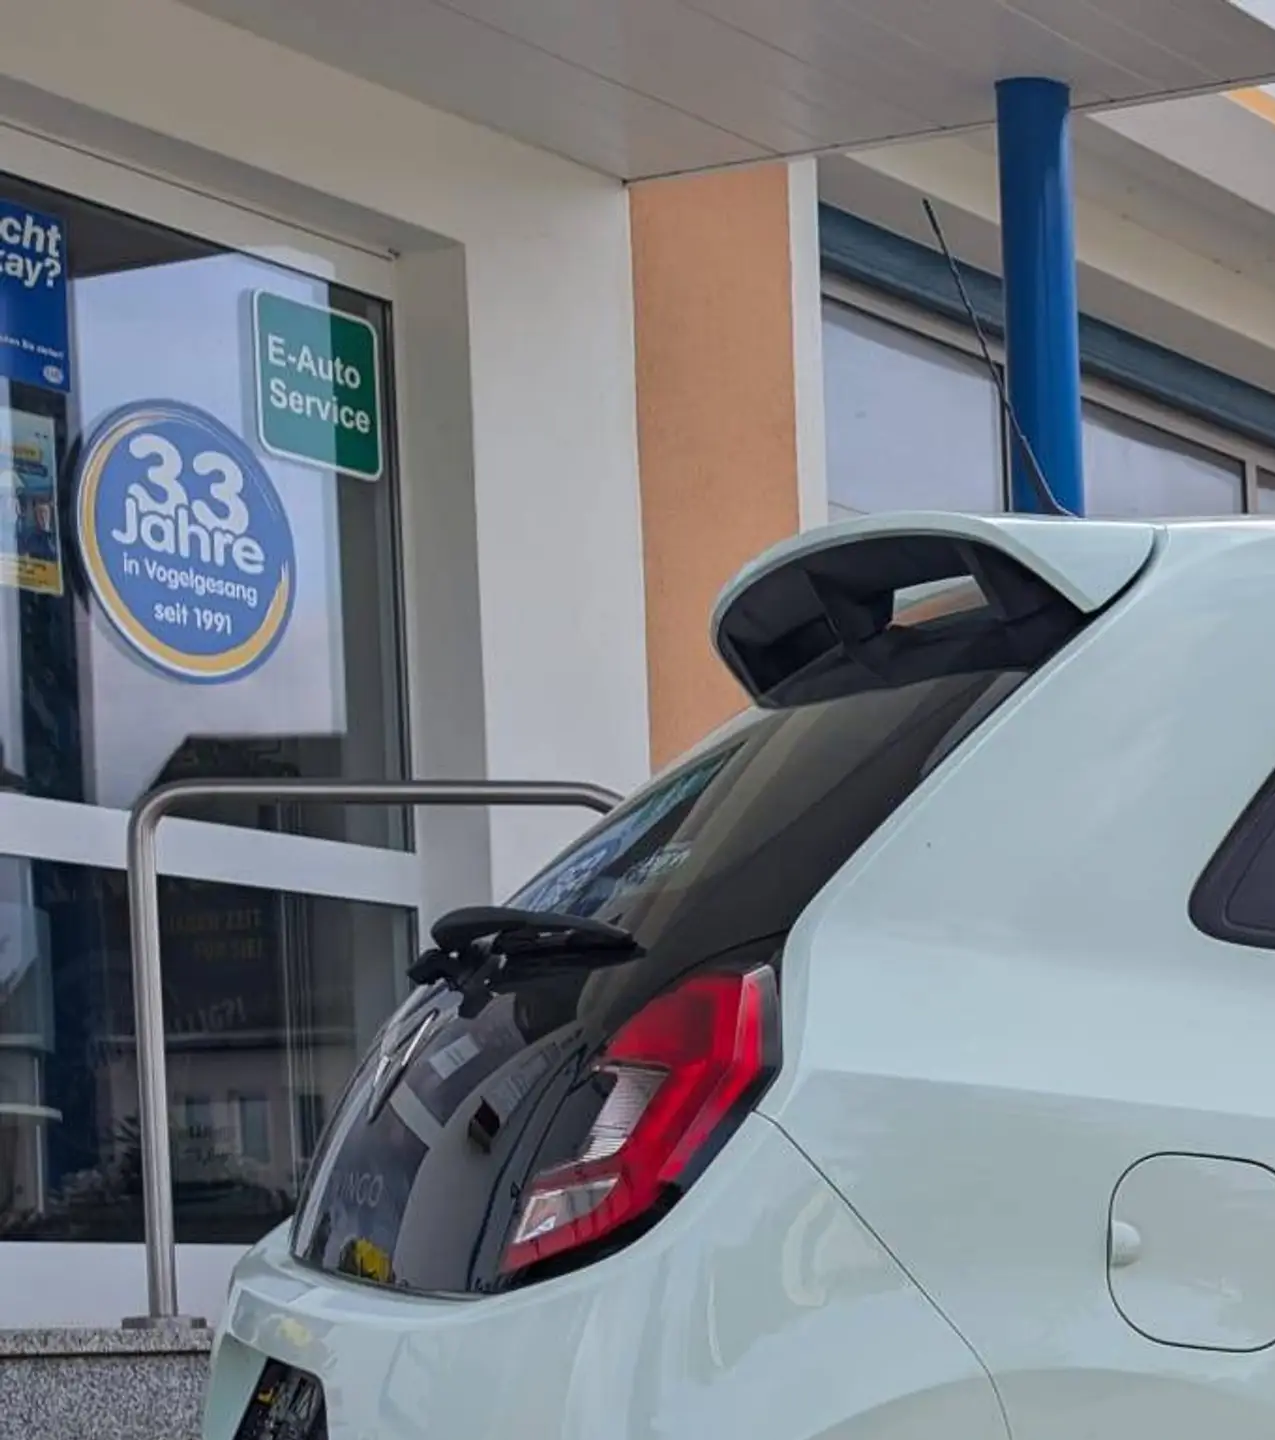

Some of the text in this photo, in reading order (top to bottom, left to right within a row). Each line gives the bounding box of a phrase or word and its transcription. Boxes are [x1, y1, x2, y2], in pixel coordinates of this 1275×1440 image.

[268, 333, 361, 389] E-Auto
[270, 377, 371, 434] Service
[128, 433, 250, 536] 33
[111, 496, 265, 575] Jahre
[123, 551, 258, 608] in Vogelgesang
[153, 601, 233, 636] seit 1991
